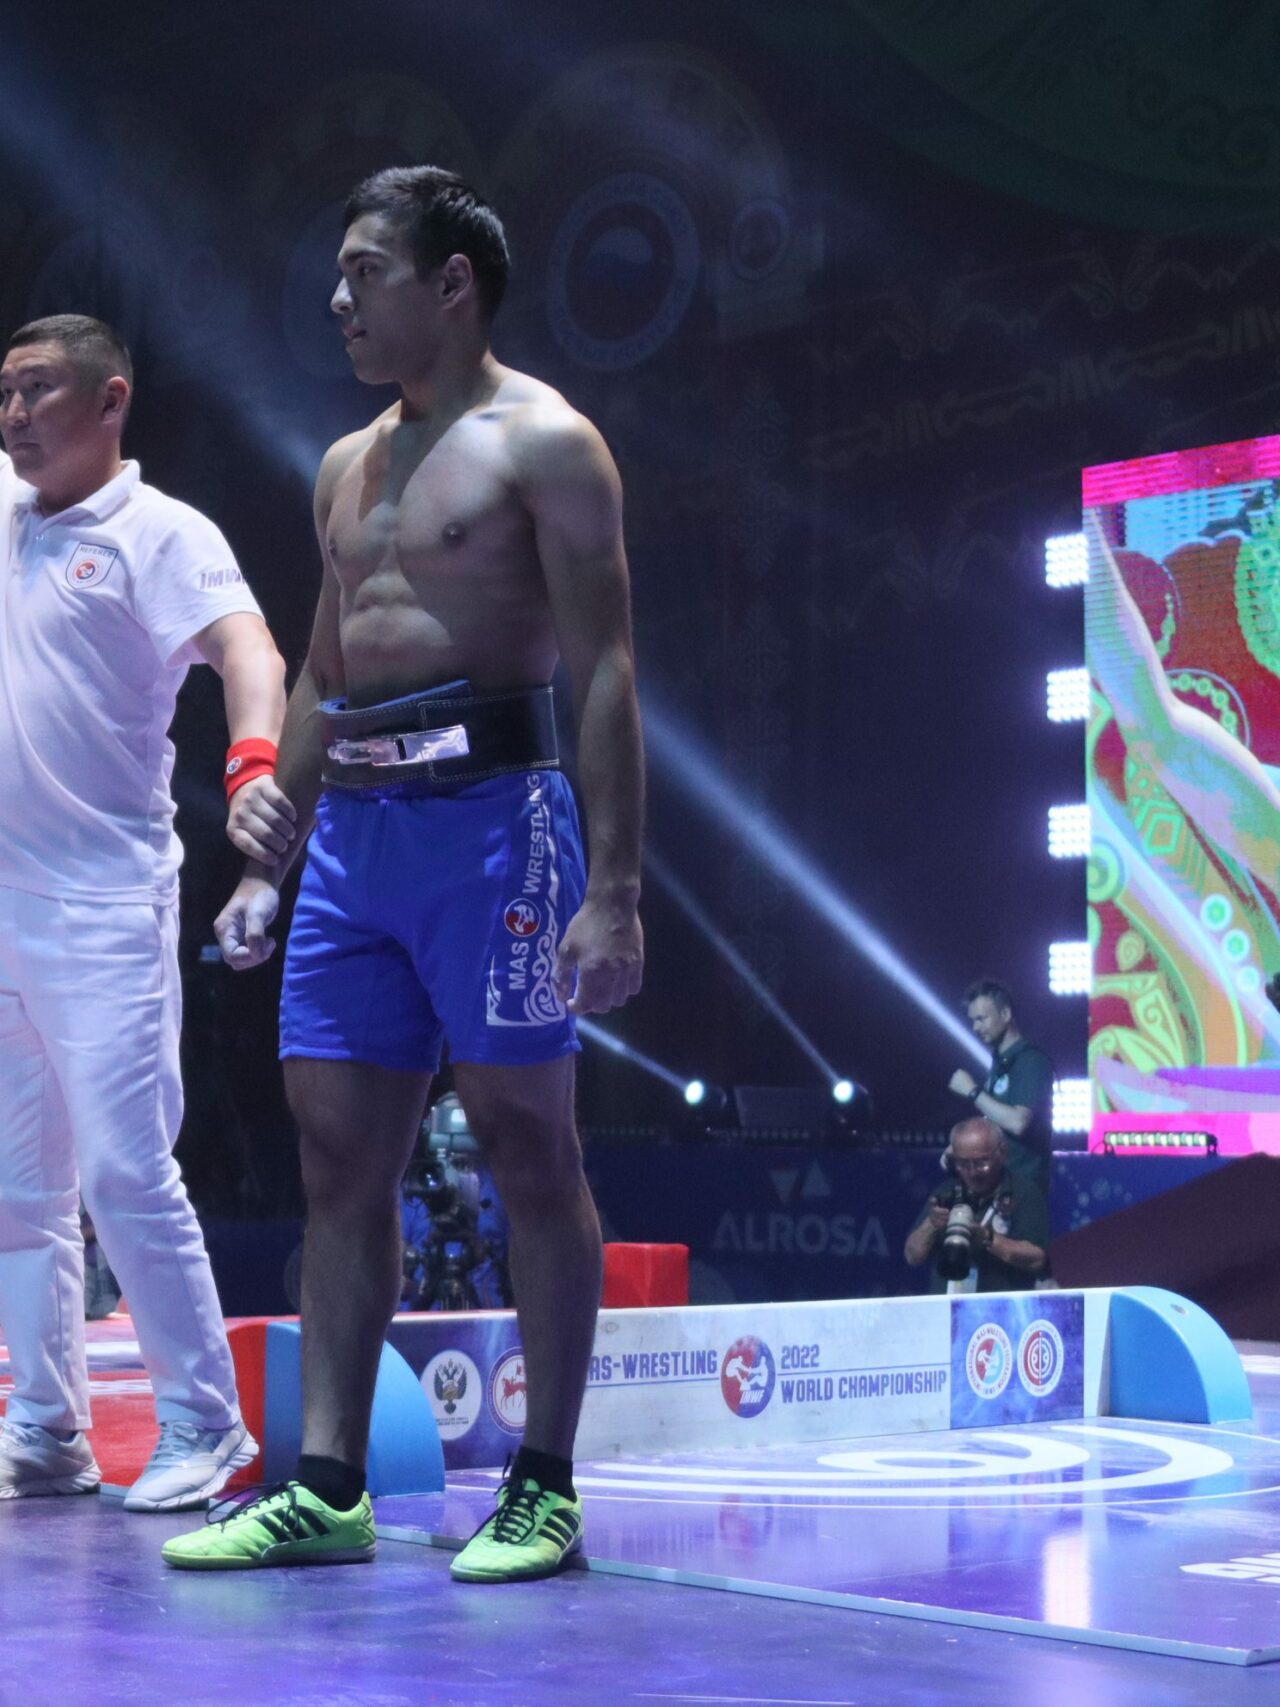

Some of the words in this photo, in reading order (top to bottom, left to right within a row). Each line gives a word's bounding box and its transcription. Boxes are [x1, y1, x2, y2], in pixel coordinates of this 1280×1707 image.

[509, 942, 529, 990] MAS
[523, 773, 545, 894] WRESTLING
[712, 1210, 890, 1257] ALROSA
[589, 1350, 718, 1381] AS-WRESTLING
[781, 1344, 820, 1369] 2022
[781, 1377, 834, 1403] WORLD
[838, 1370, 947, 1400] CHAMPIONSHIP
